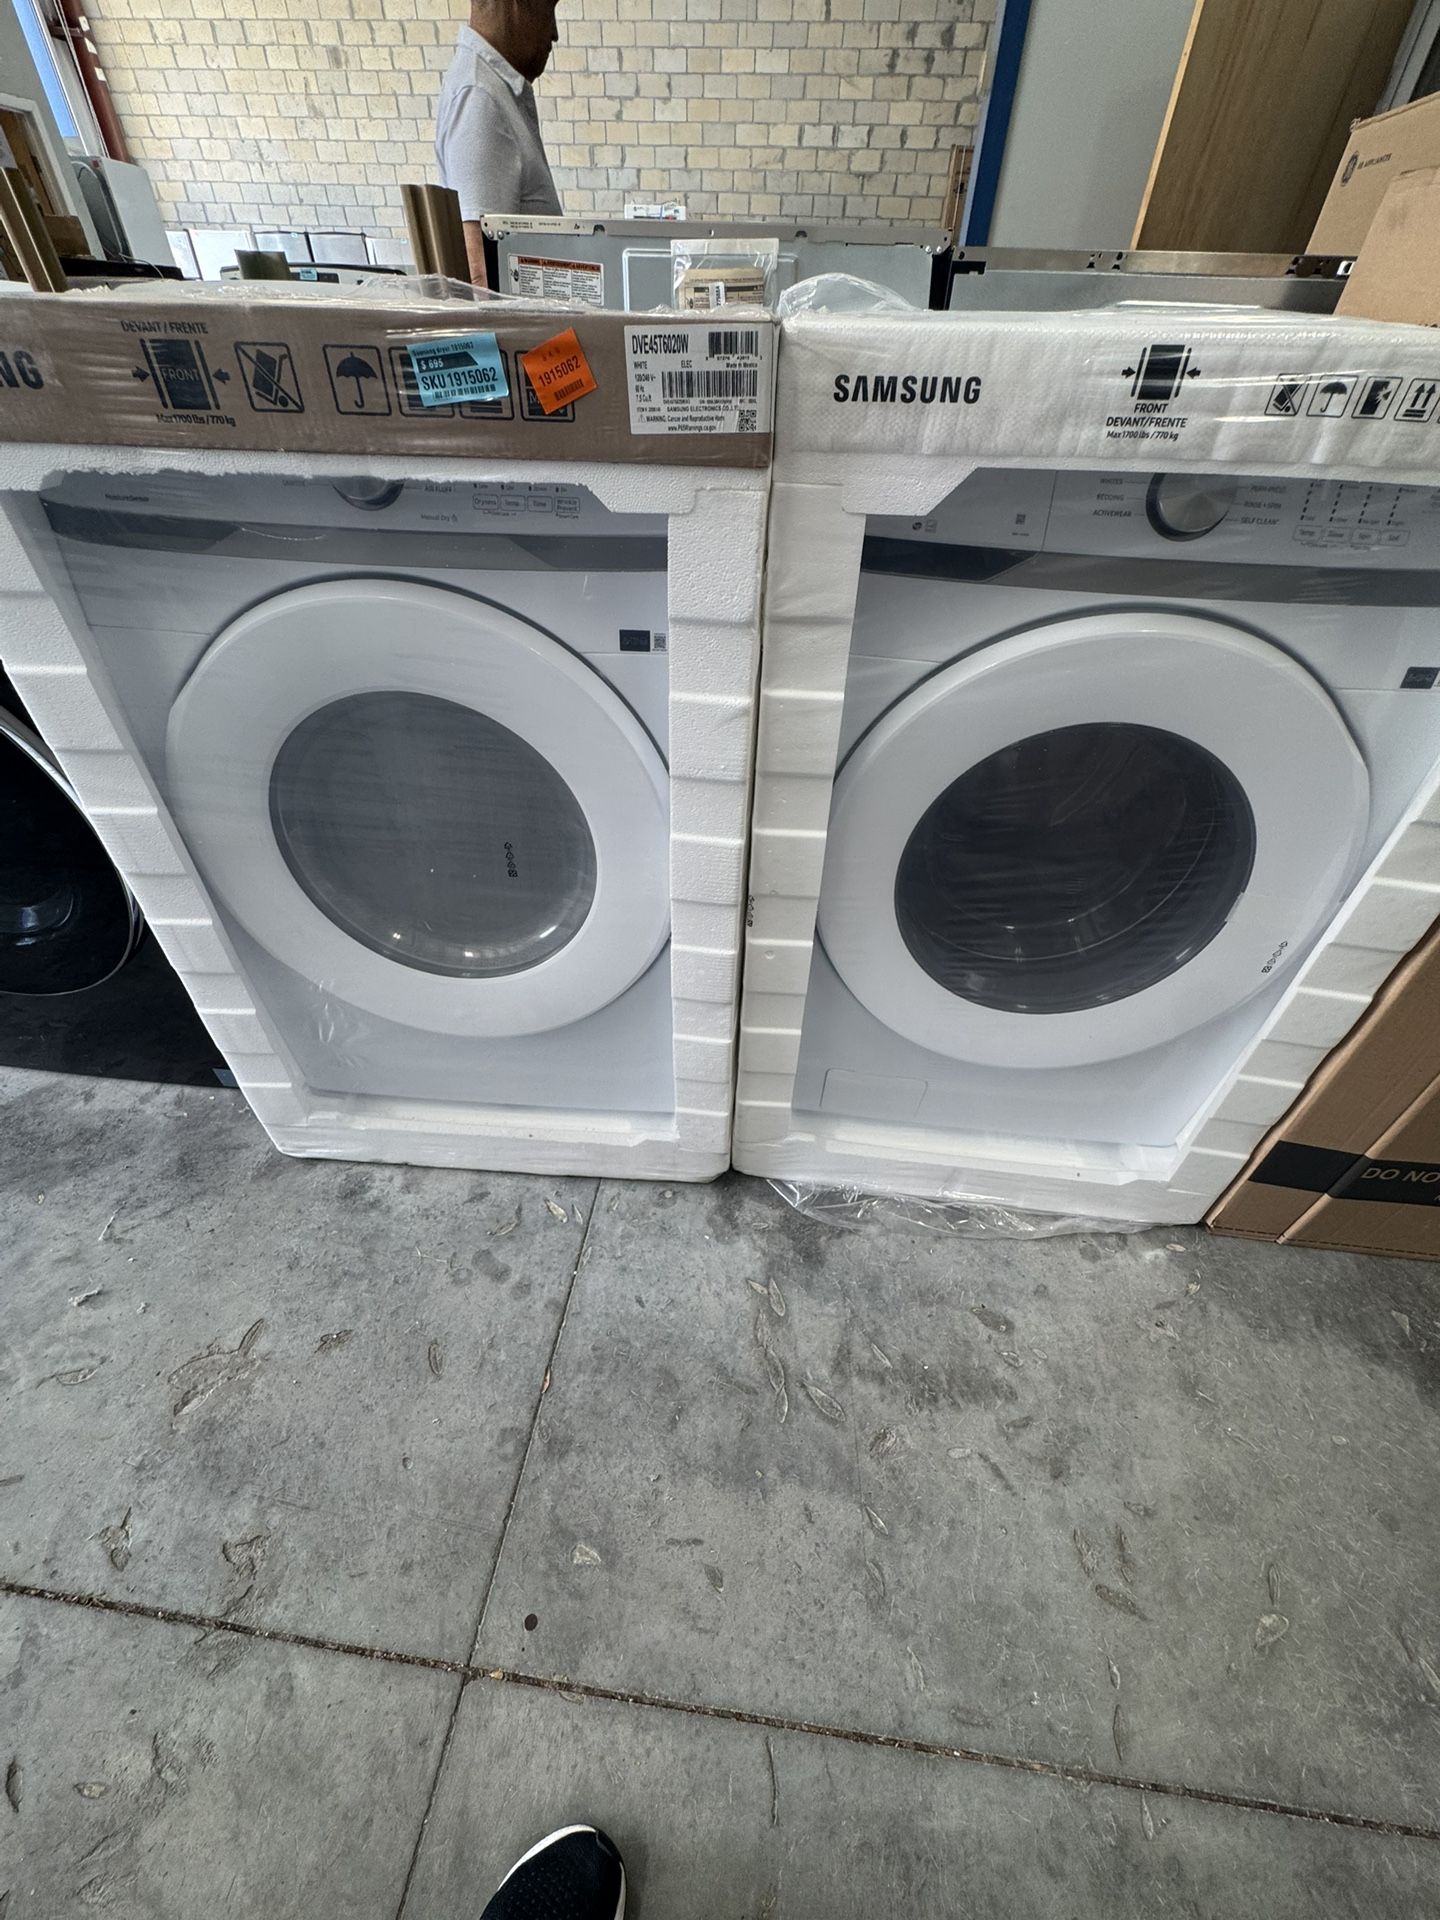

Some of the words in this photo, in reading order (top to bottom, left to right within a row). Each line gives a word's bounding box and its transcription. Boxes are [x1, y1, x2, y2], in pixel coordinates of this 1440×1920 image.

[121, 320, 161, 333] DEVANT
[169, 322, 208, 334] FRENTE
[632, 334, 689, 354] DVE45T6020W
[428, 360, 444, 369] 695
[633, 361, 648, 369] WHITE
[681, 360, 692, 369] ELEC
[162, 367, 200, 381] FRONT
[421, 374, 445, 391] SKU
[449, 366, 498, 387] 1915062
[538, 356, 581, 388] 1915062
[834, 374, 982, 404] SAMSUNG
[1134, 403, 1168, 414] FRONT
[1122, 431, 1138, 439] 1700
[1169, 431, 1179, 442] kg
[1093, 509, 1132, 518] ACTIVEWEAR
[1361, 1167, 1400, 1180] DO
